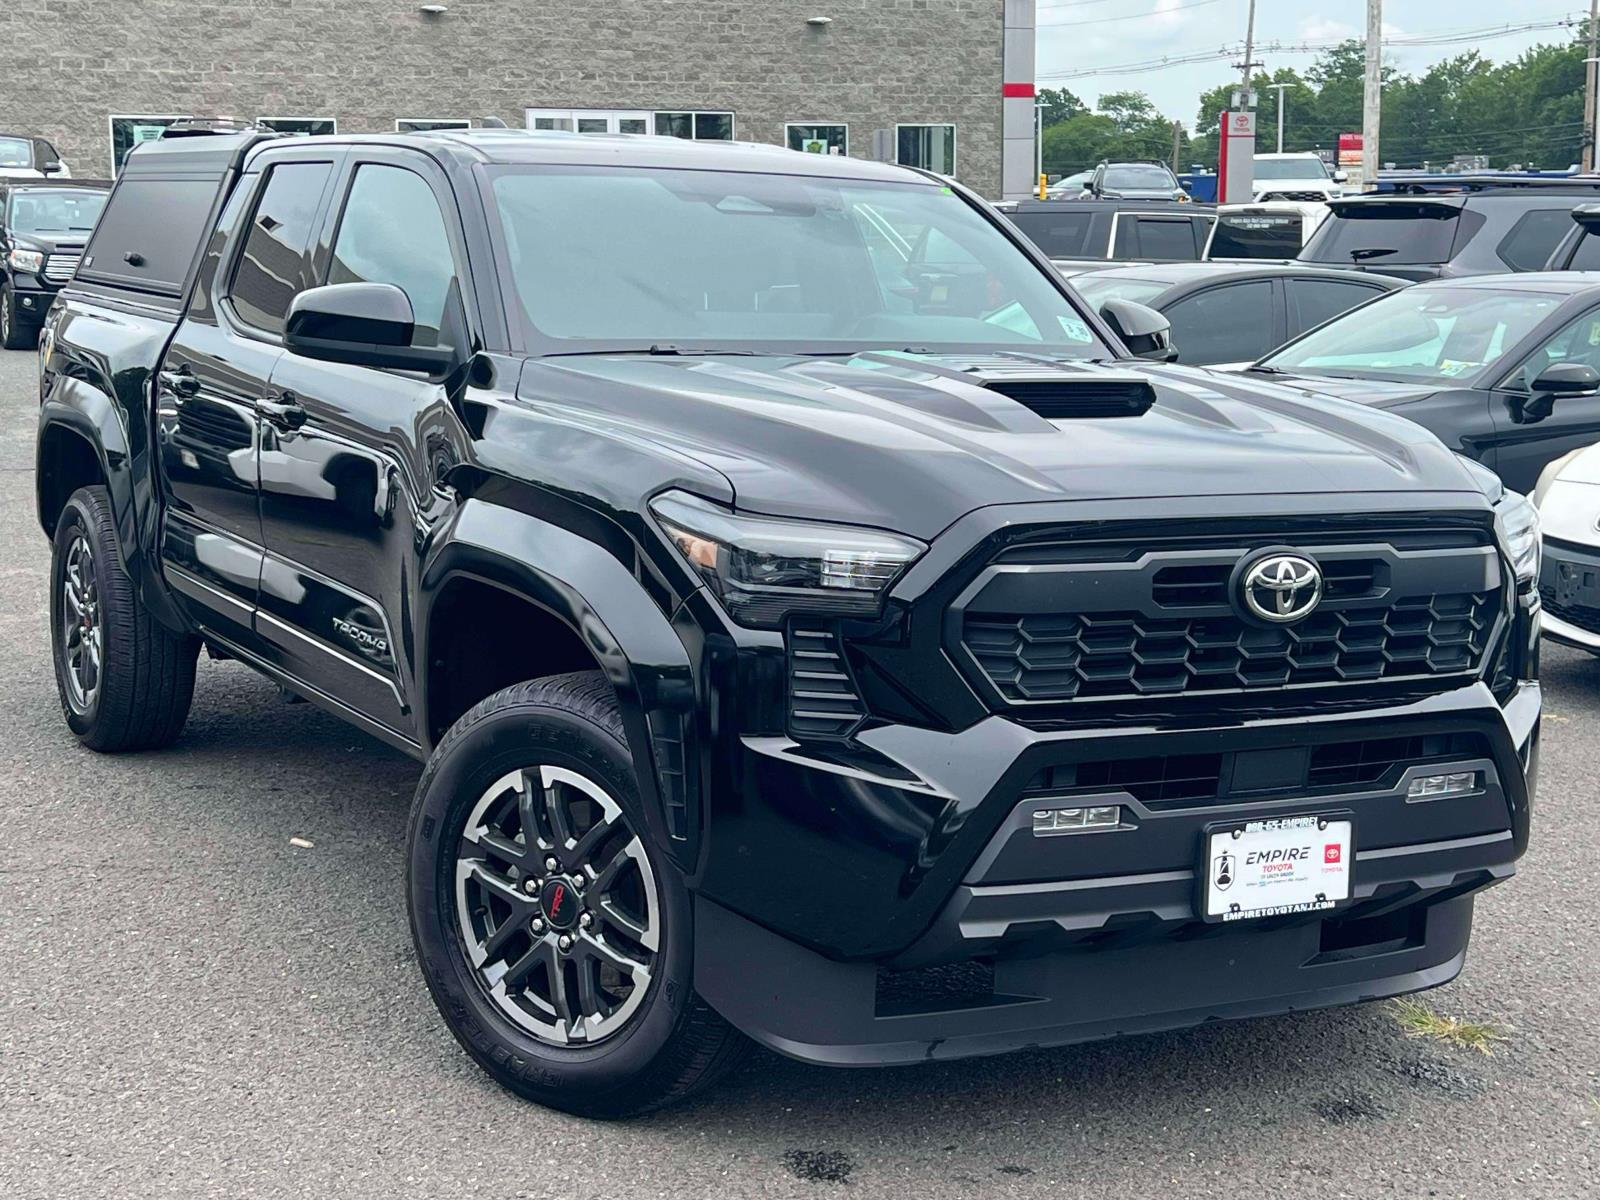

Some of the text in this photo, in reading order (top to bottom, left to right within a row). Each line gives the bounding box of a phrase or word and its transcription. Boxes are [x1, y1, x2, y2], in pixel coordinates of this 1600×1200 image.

[1246, 846, 1311, 865] EMPIRE
[1263, 863, 1293, 873] TOYOTA
[1223, 900, 1335, 921] EMPIRETOYOTANJ.COM
